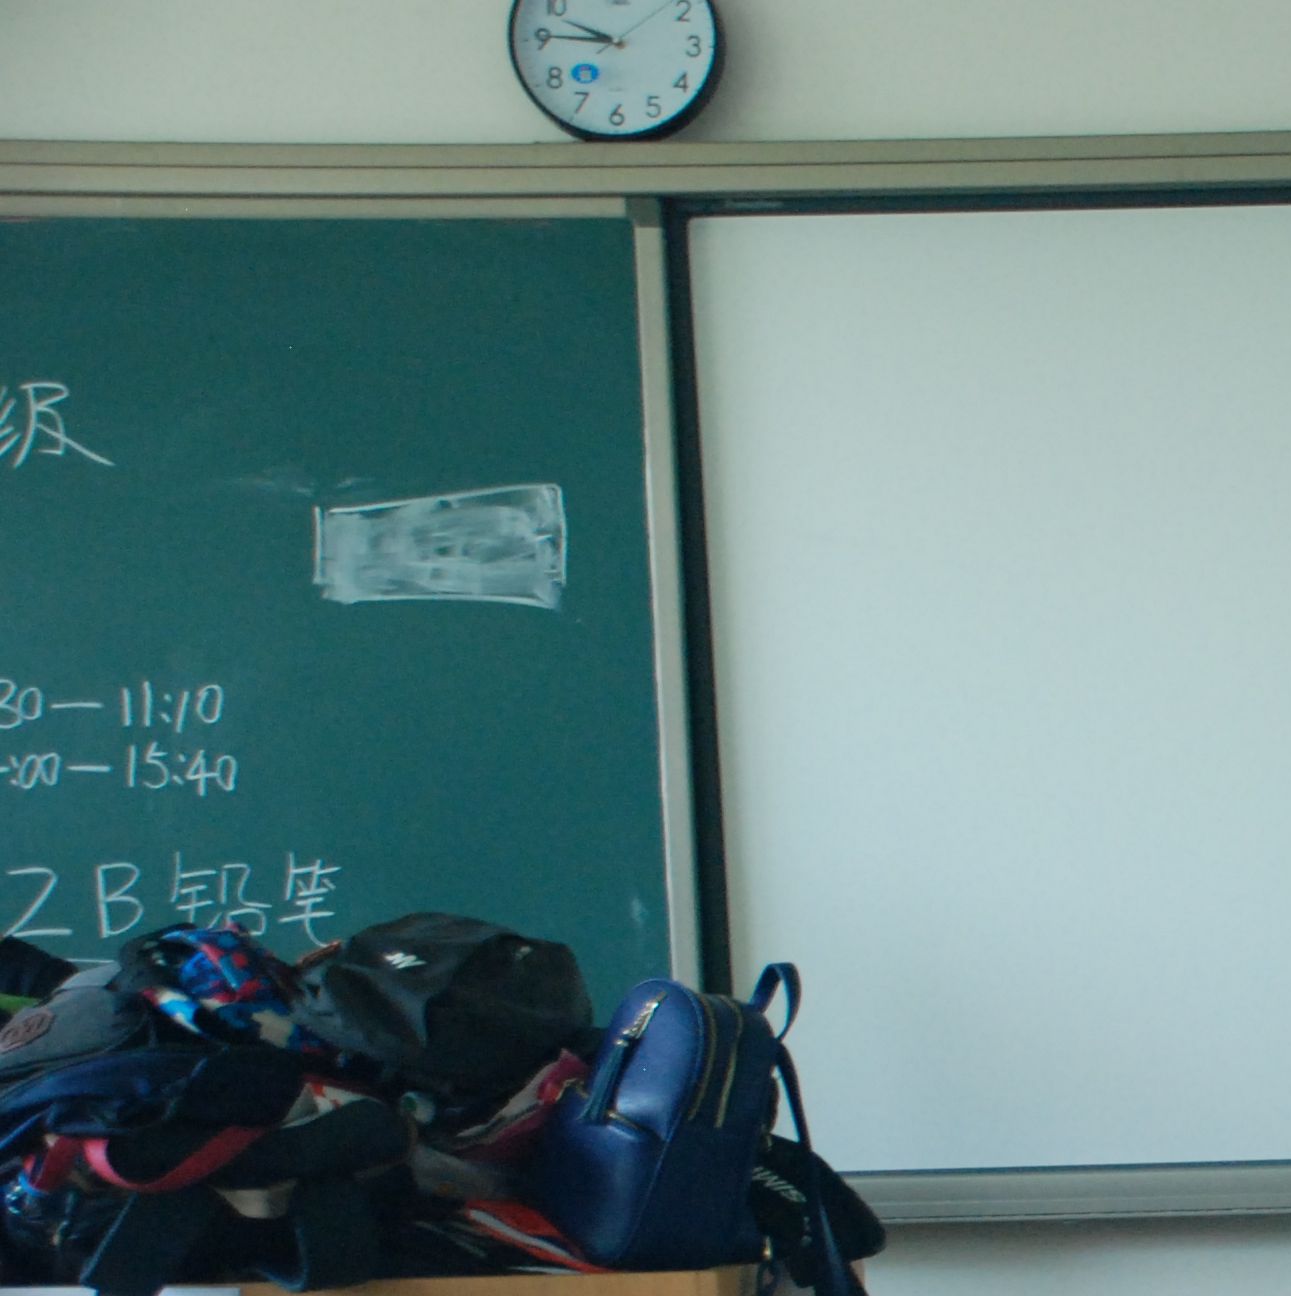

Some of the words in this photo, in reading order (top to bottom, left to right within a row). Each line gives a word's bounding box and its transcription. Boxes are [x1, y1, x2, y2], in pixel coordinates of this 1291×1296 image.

[675, 0, 691, 22] 2
[534, 28, 551, 50] 9
[686, 35, 701, 57] 3
[546, 67, 563, 89] 8
[673, 72, 688, 92] 4
[574, 92, 589, 114] 7
[646, 96, 662, 118] 5
[609, 104, 625, 126] 6
